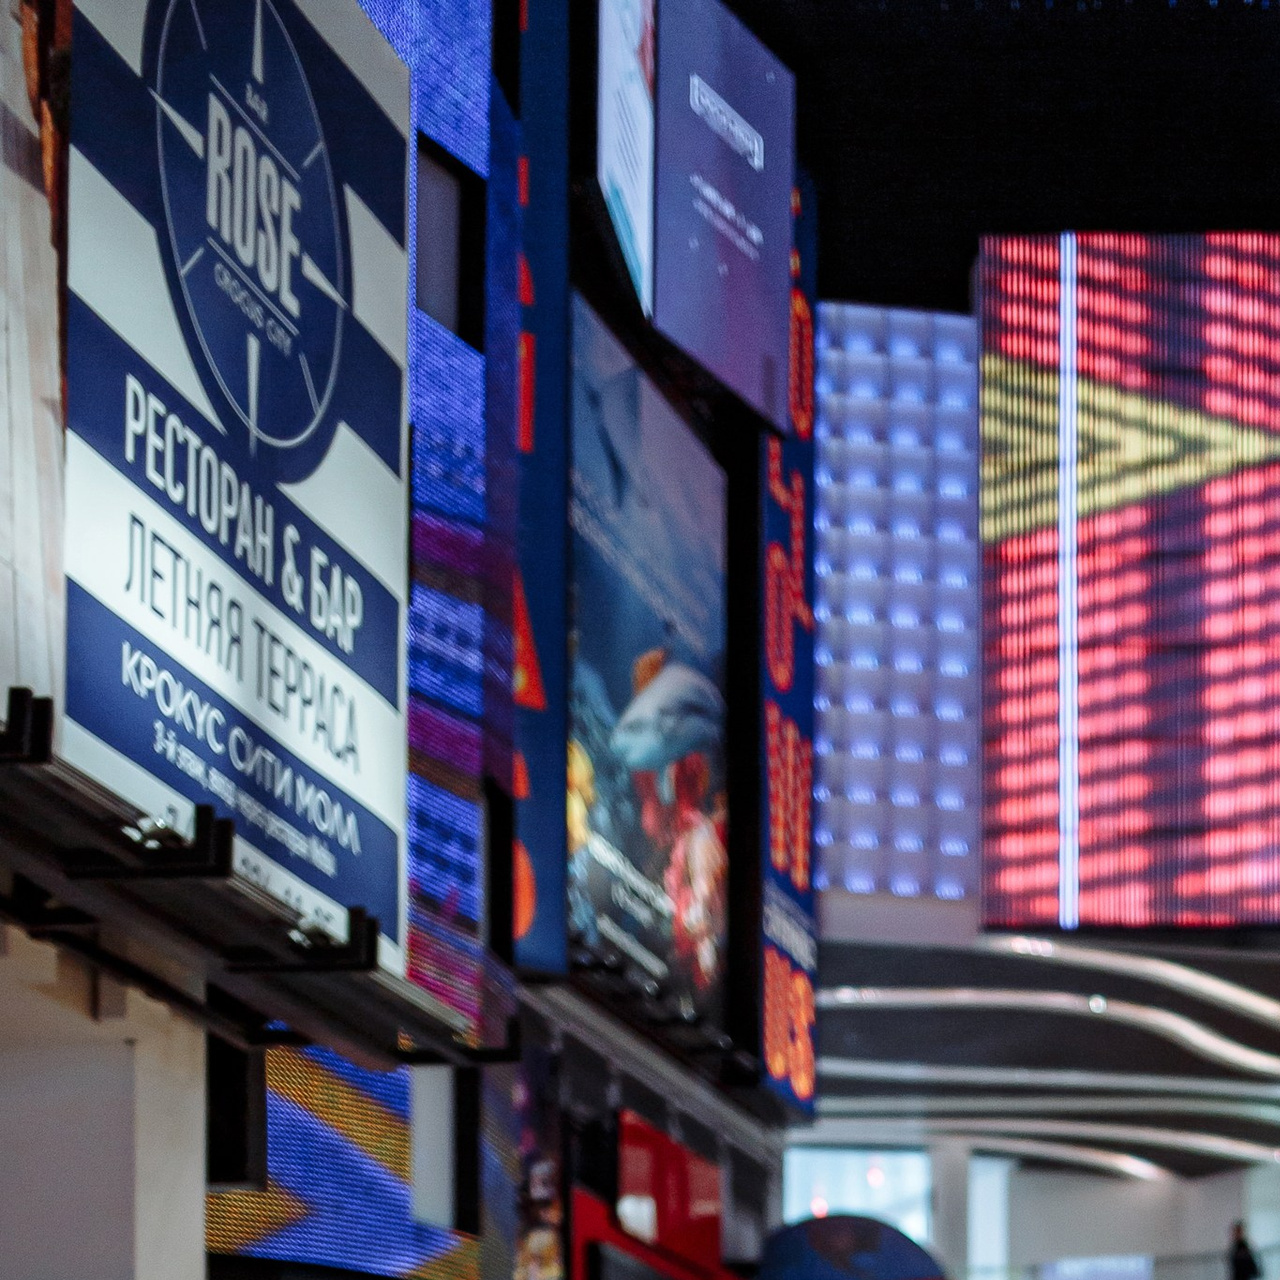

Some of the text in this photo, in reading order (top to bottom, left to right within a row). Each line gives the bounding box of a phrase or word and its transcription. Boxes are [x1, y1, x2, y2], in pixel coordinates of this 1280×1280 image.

[206, 92, 300, 319] ROSE
[125, 372, 364, 655] РЕСТОРАН & БАР
[121, 640, 226, 755] КРОКУС
[125, 511, 361, 775] ЛЕТНЯЯ ТЕРРАСА
